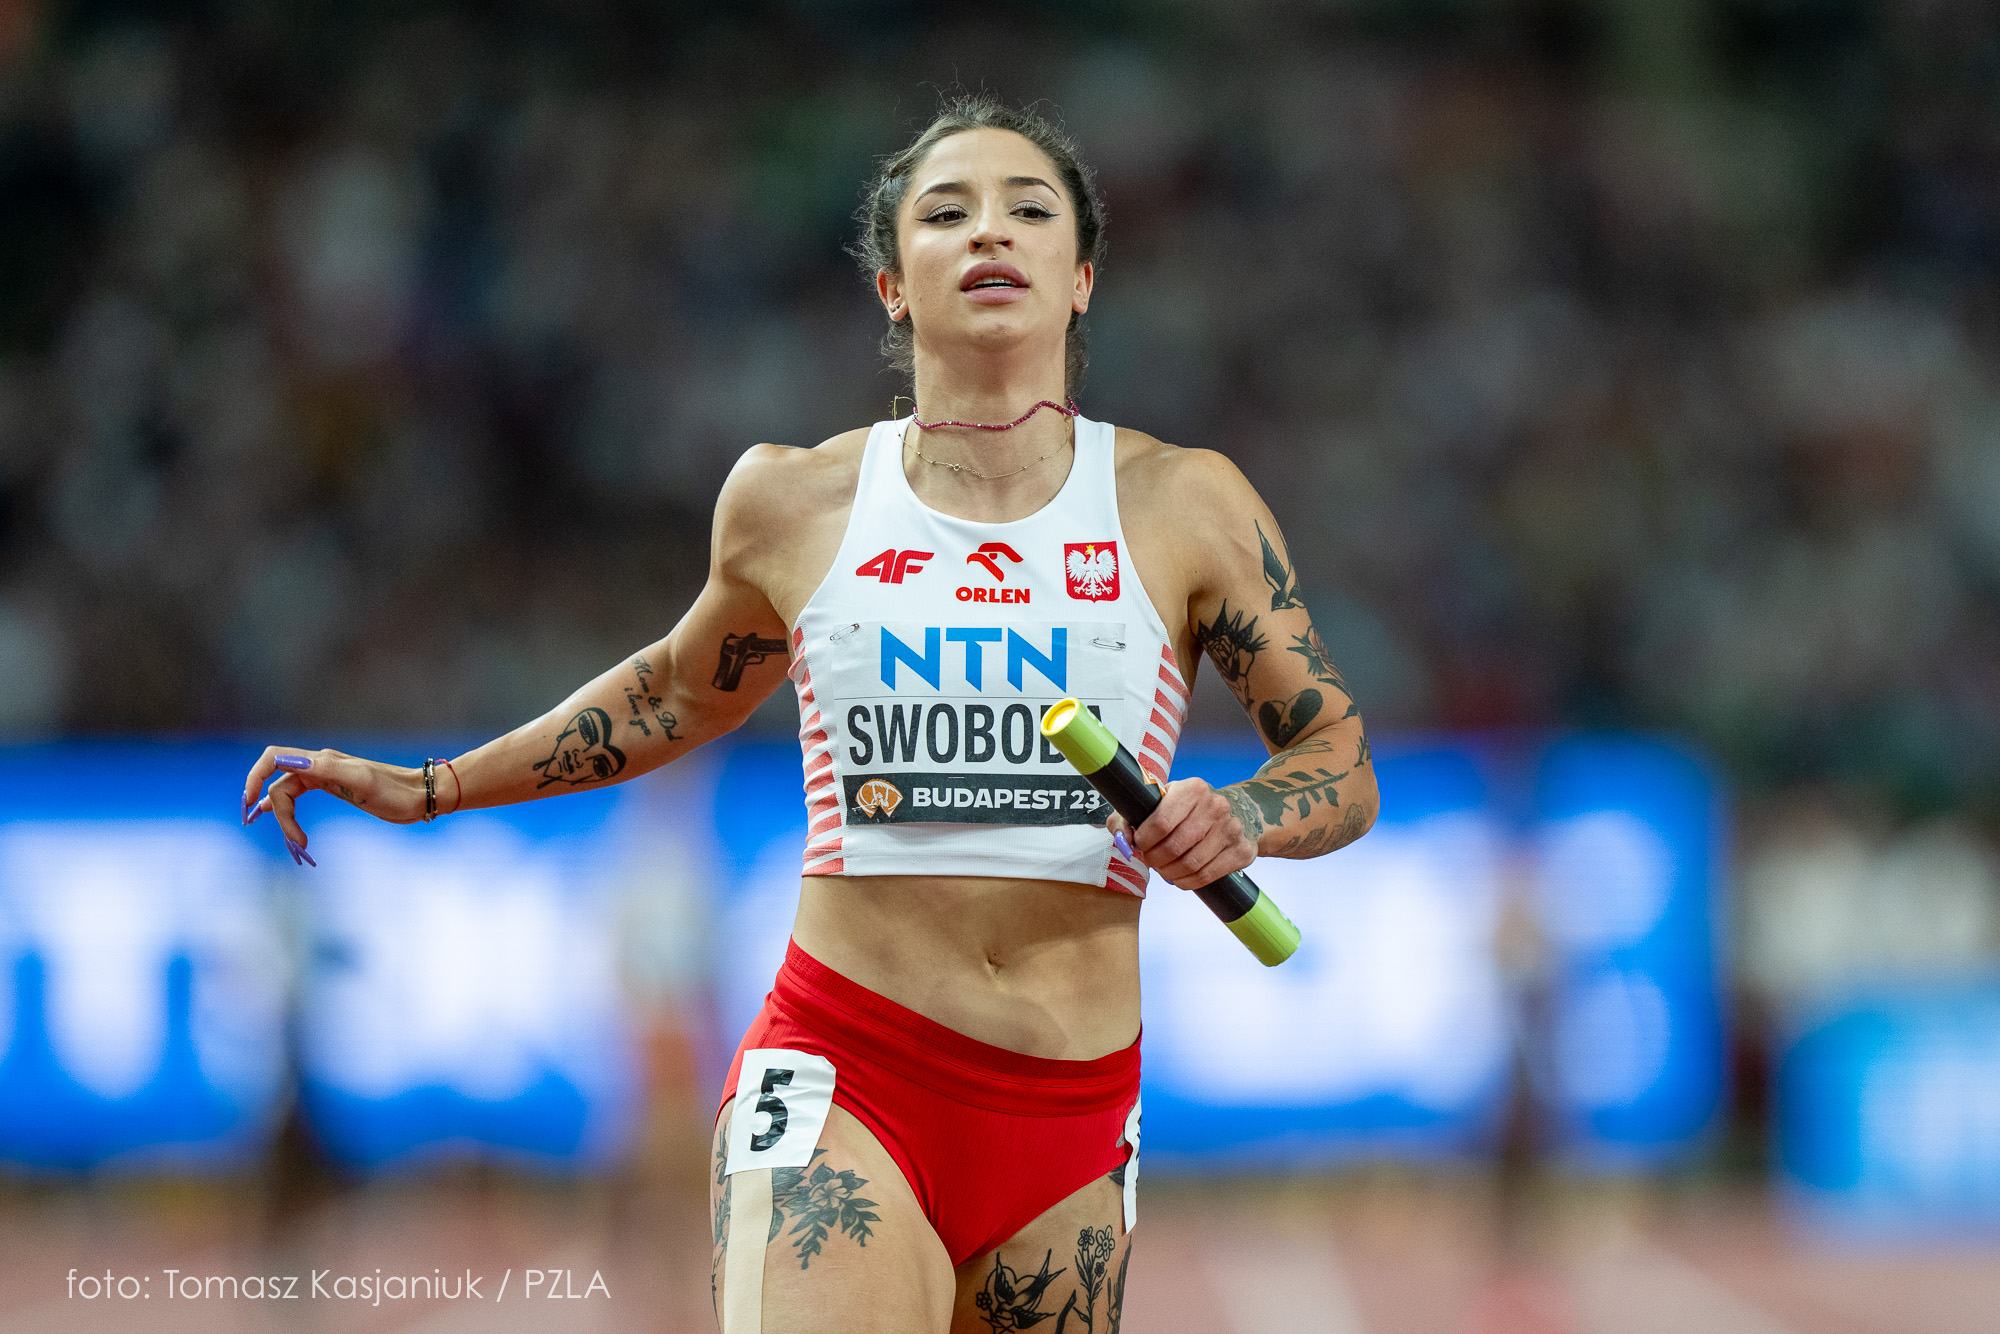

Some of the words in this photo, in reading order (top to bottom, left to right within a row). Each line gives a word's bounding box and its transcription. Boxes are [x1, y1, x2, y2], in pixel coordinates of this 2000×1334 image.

[856, 549, 934, 584] 4F
[955, 586, 1030, 604] ORLEN
[881, 626, 1067, 693] NTN
[847, 703, 1103, 766] SWOBO
[912, 788, 1066, 810] BUDAPEST
[1069, 790, 1101, 809] 23
[749, 1068, 795, 1152] 5
